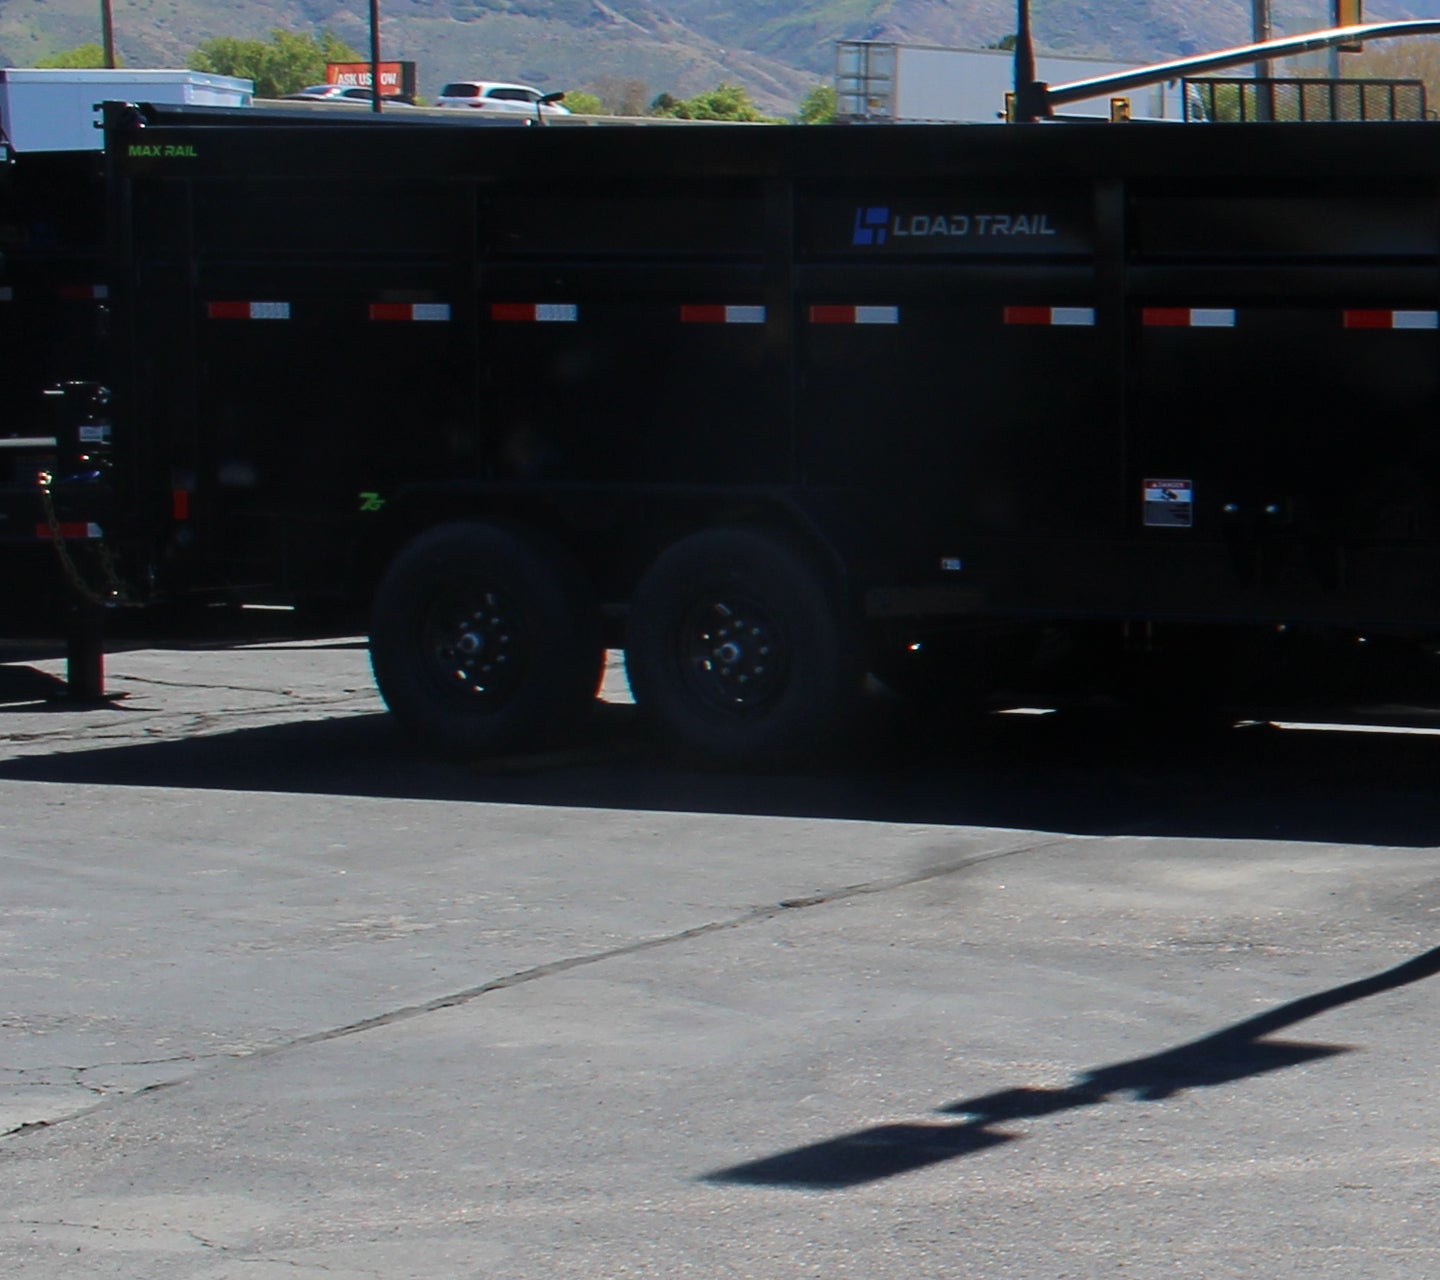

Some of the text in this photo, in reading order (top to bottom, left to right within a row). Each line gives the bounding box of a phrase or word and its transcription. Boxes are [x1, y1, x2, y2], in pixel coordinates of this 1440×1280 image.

[338, 73, 357, 86] ASK
[358, 72, 373, 86] US
[128, 145, 199, 157] MAX RAIL
[893, 214, 1056, 236] LOAD TRAIL
